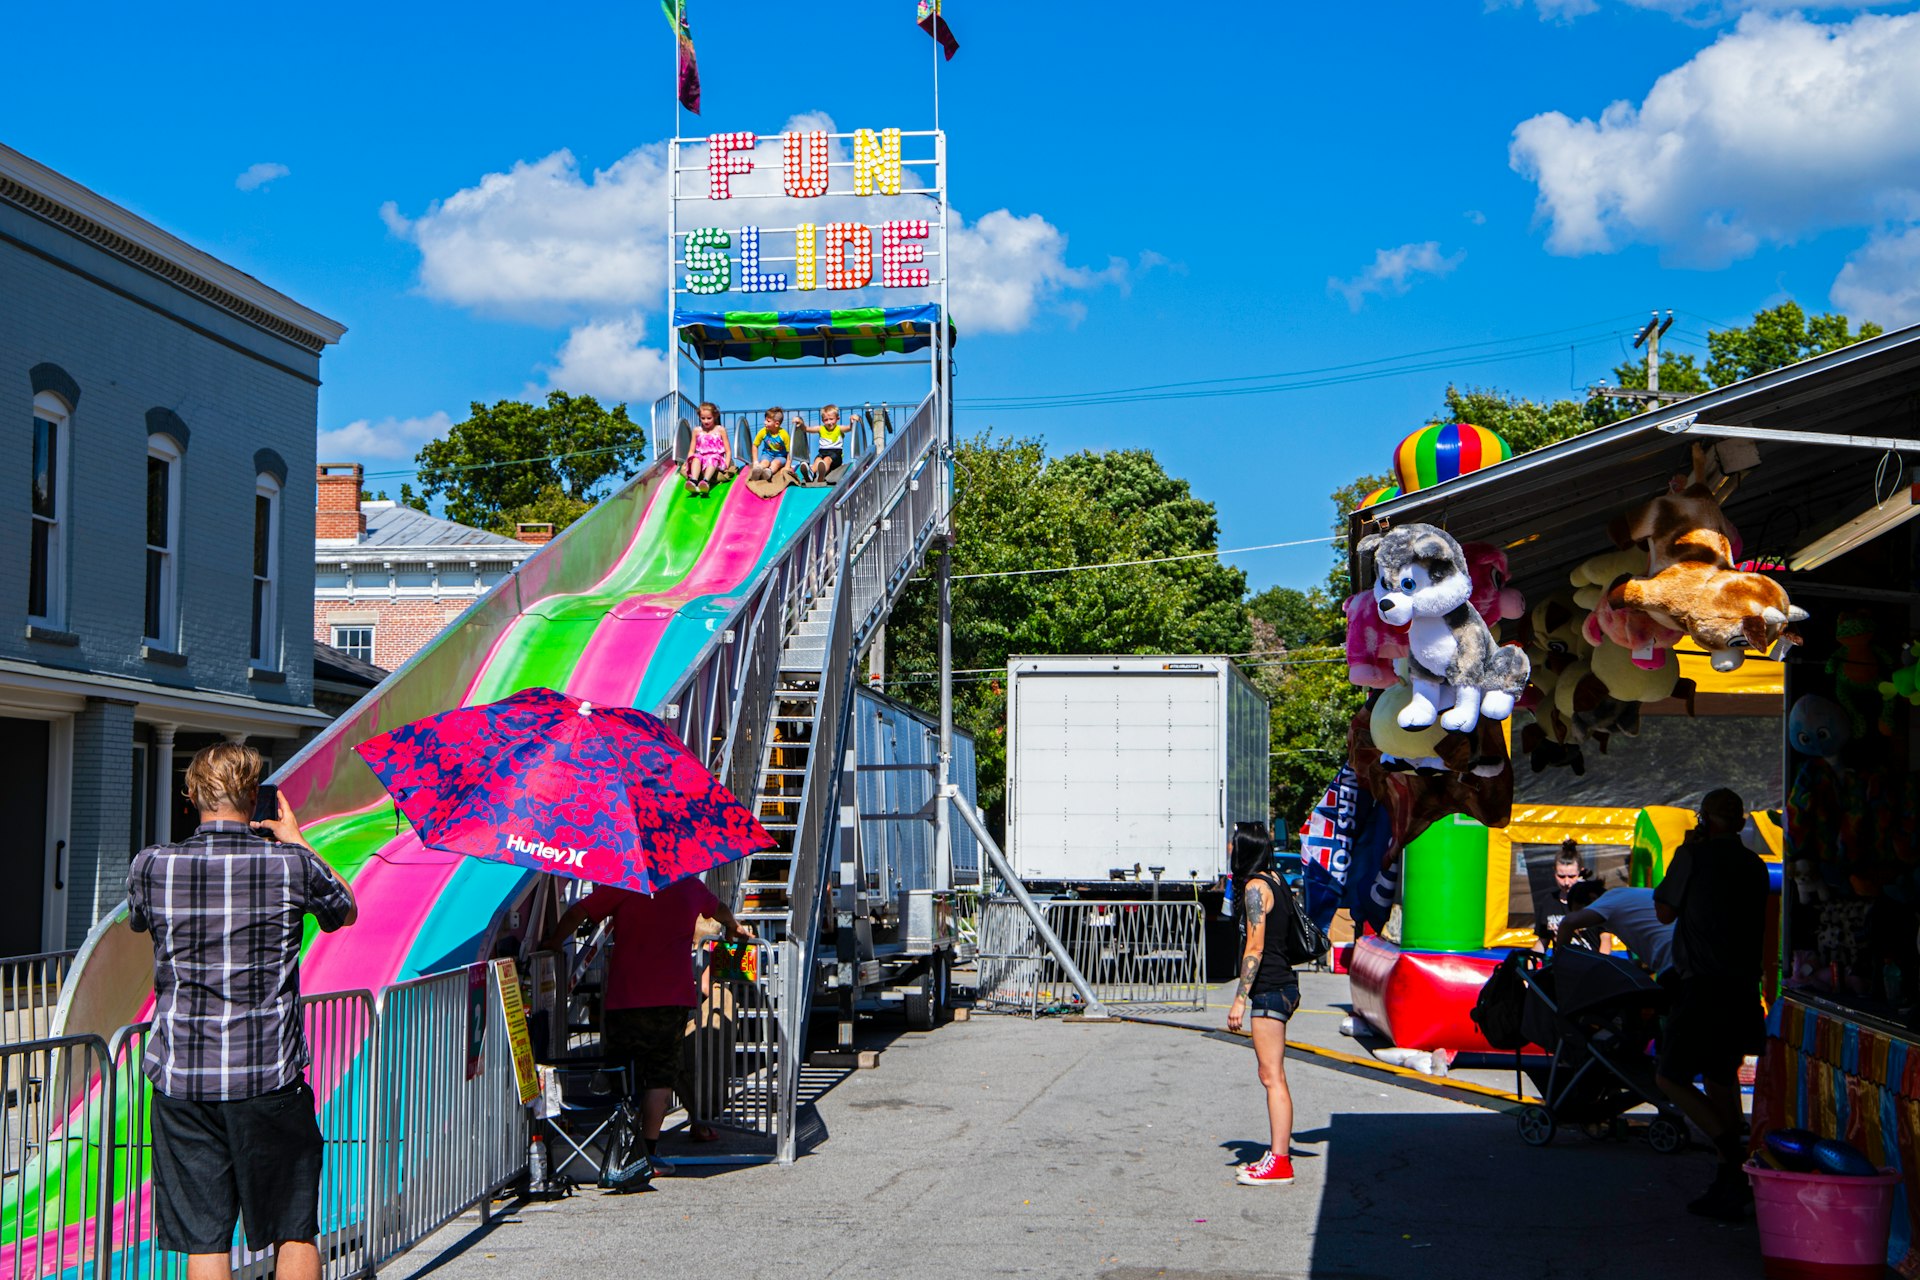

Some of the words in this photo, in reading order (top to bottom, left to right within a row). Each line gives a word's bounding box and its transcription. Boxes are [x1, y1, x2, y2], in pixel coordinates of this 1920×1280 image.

[709, 128, 901, 200] FUN
[684, 220, 929, 294] SLIDE
[1337, 766, 1358, 830] NERS
[506, 834, 567, 864] Hurley
[474, 1003, 481, 1043] 2
